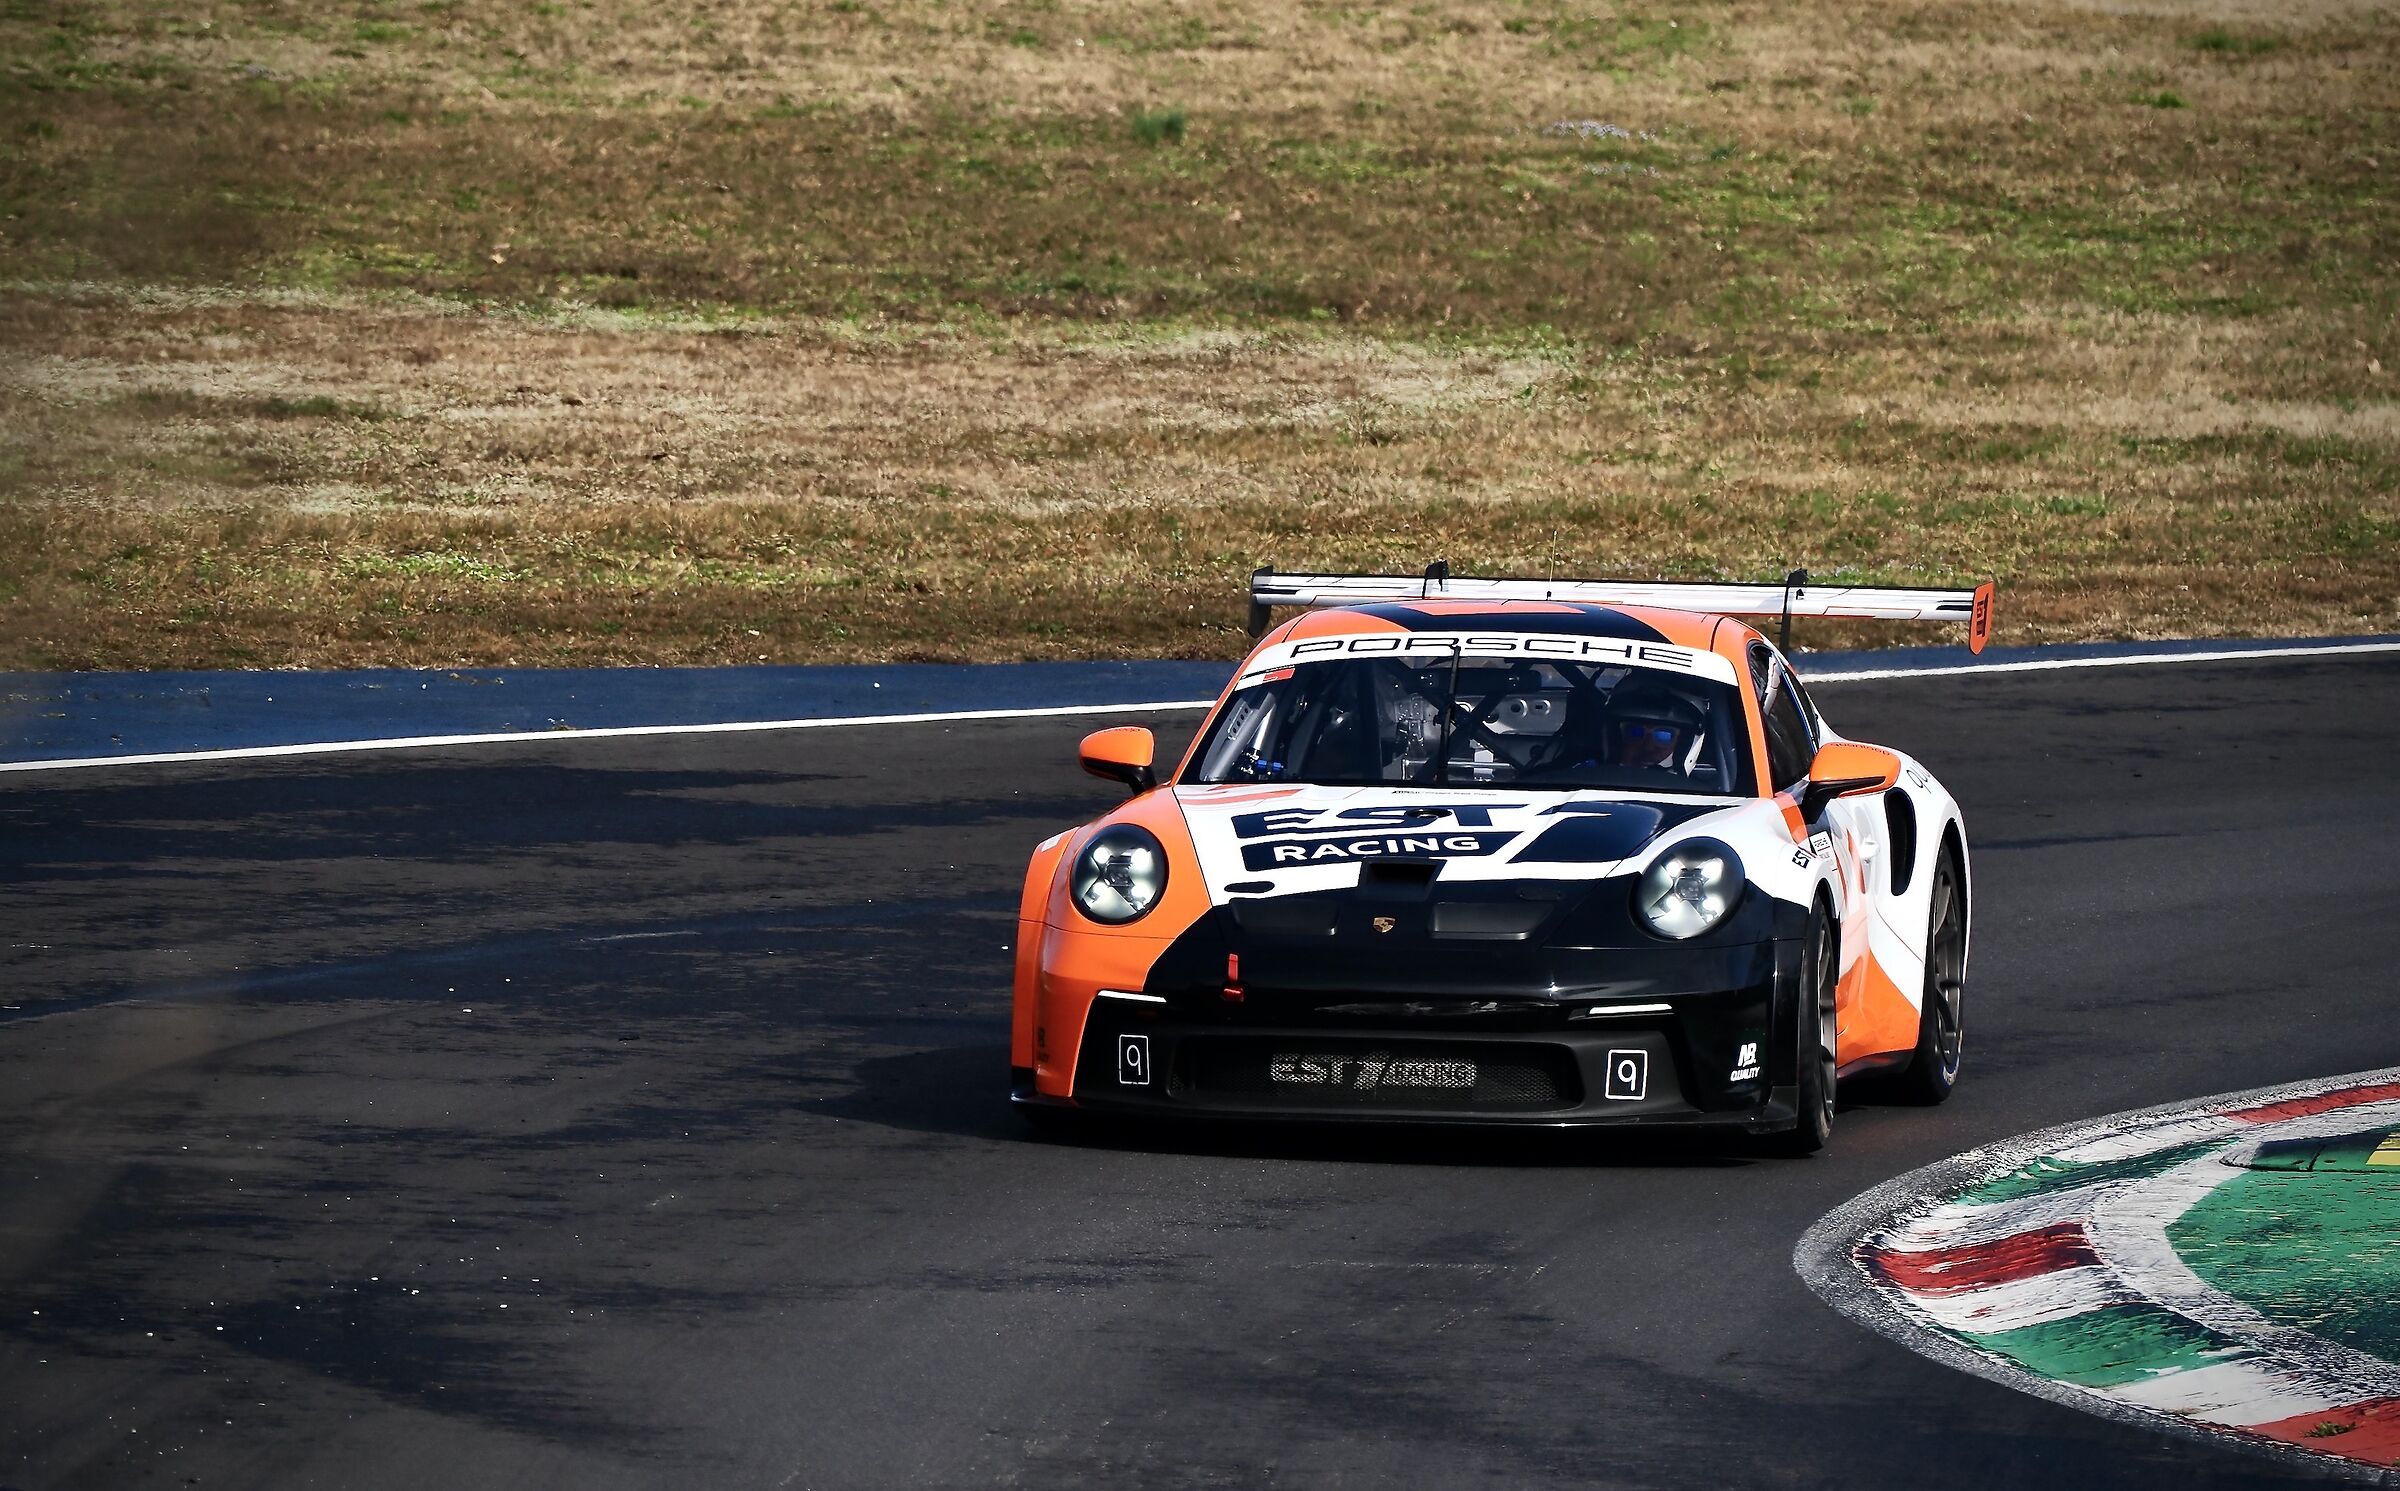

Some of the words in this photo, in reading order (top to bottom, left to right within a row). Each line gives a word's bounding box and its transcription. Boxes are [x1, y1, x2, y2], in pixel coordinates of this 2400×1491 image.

[1290, 636, 1694, 668] PORSCHE
[1231, 803, 1531, 839] EST
[1273, 836, 1481, 862] RACING
[1126, 1044, 1141, 1076] 9
[1270, 1053, 1353, 1085] EST
[1617, 1059, 1637, 1092] 9
